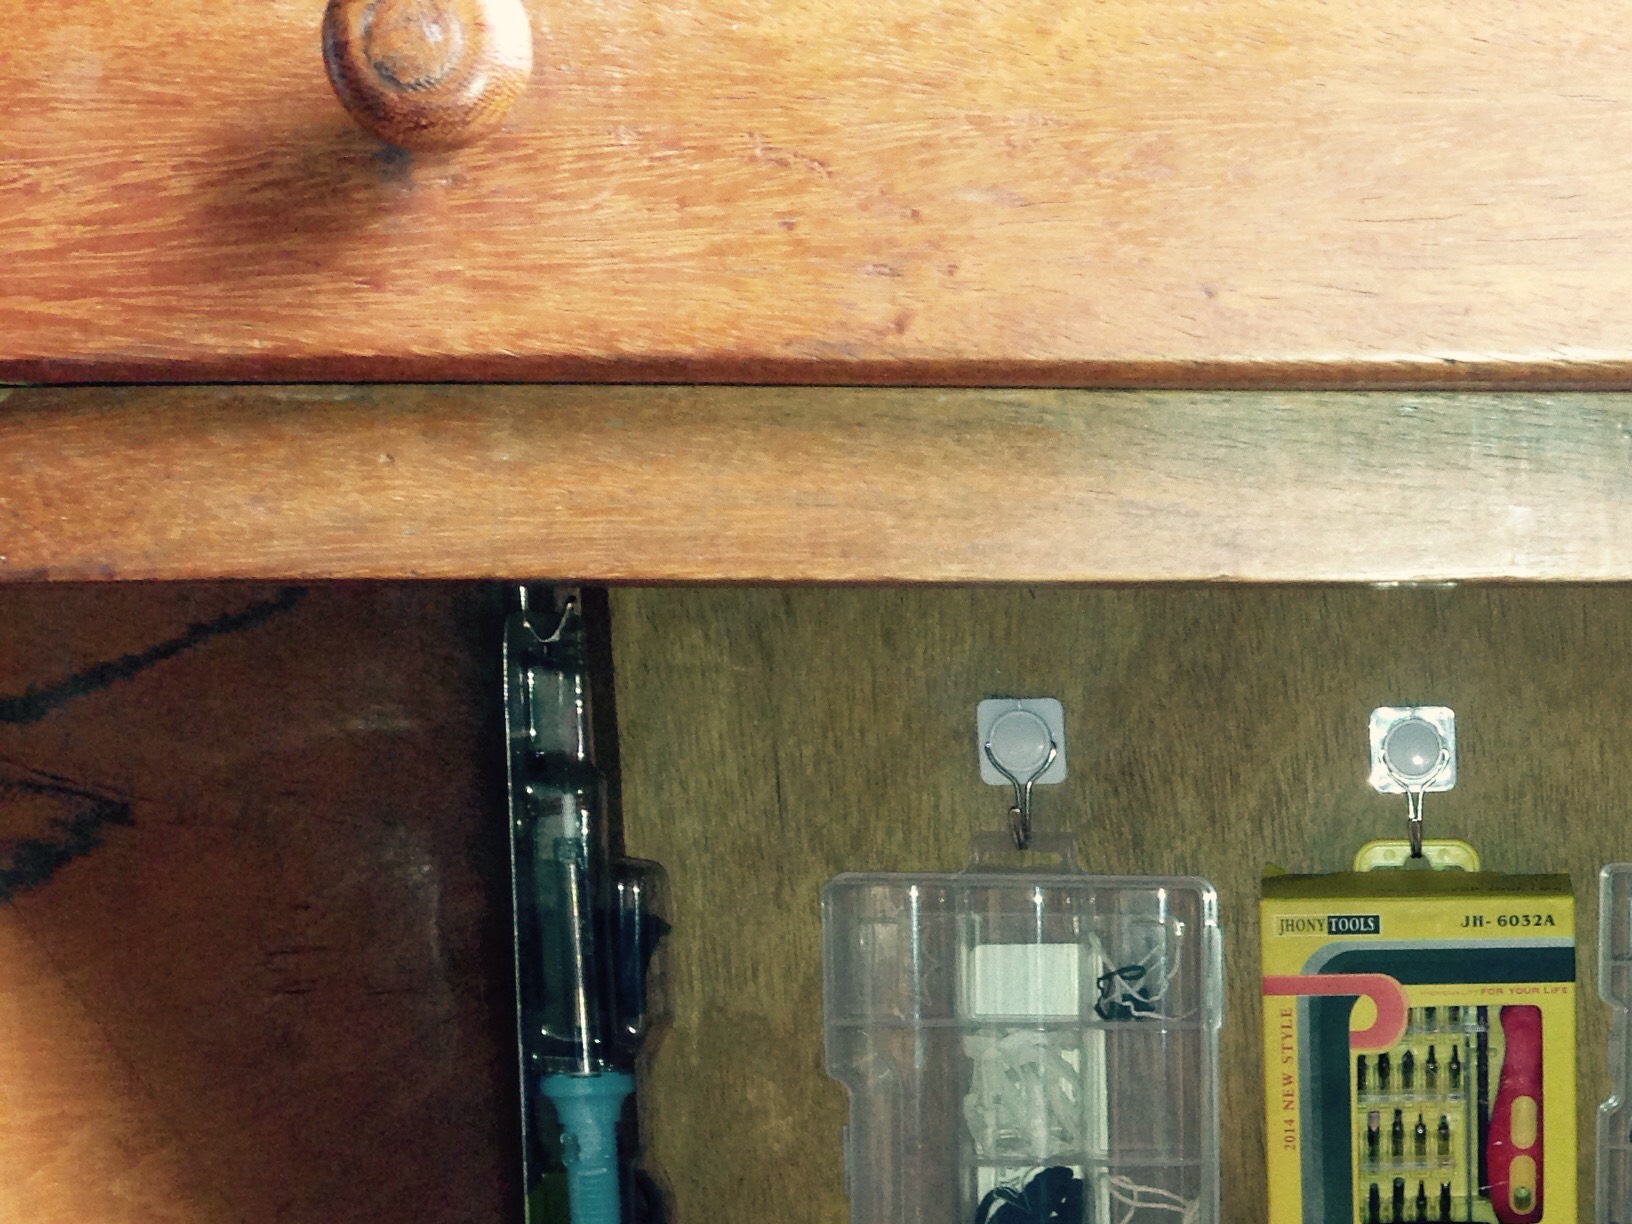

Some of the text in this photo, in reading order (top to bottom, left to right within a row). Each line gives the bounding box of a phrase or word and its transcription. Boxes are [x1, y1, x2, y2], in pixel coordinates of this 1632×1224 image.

[1279, 917, 1376, 935] JHONY TOOLS
[1481, 987, 1503, 995] FOR
[1509, 987, 1540, 995] YOUR
[1281, 1007, 1297, 1151] 2014 NEW STYLE
